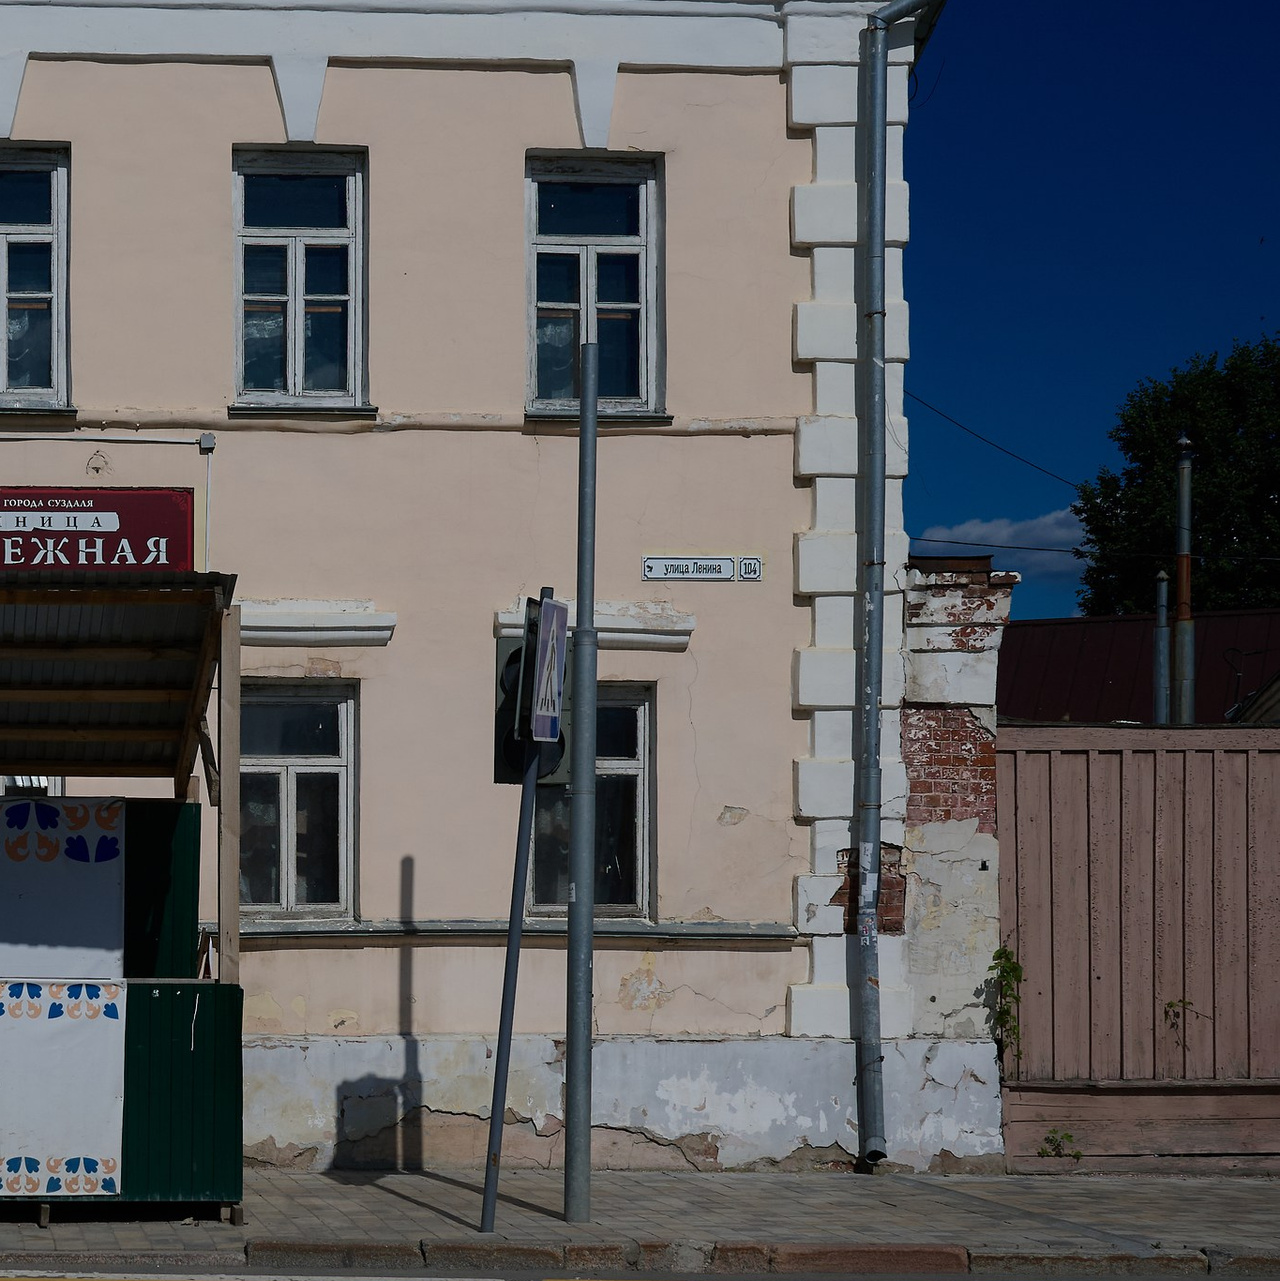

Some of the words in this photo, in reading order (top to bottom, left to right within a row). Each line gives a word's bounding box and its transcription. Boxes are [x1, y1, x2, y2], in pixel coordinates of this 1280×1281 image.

[3, 498, 44, 509] ГОРОДА
[47, 499, 94, 508] СУЗДАЛЯ
[663, 563, 690, 576] улица
[691, 561, 723, 575] Ленина
[743, 562, 758, 575] 104
